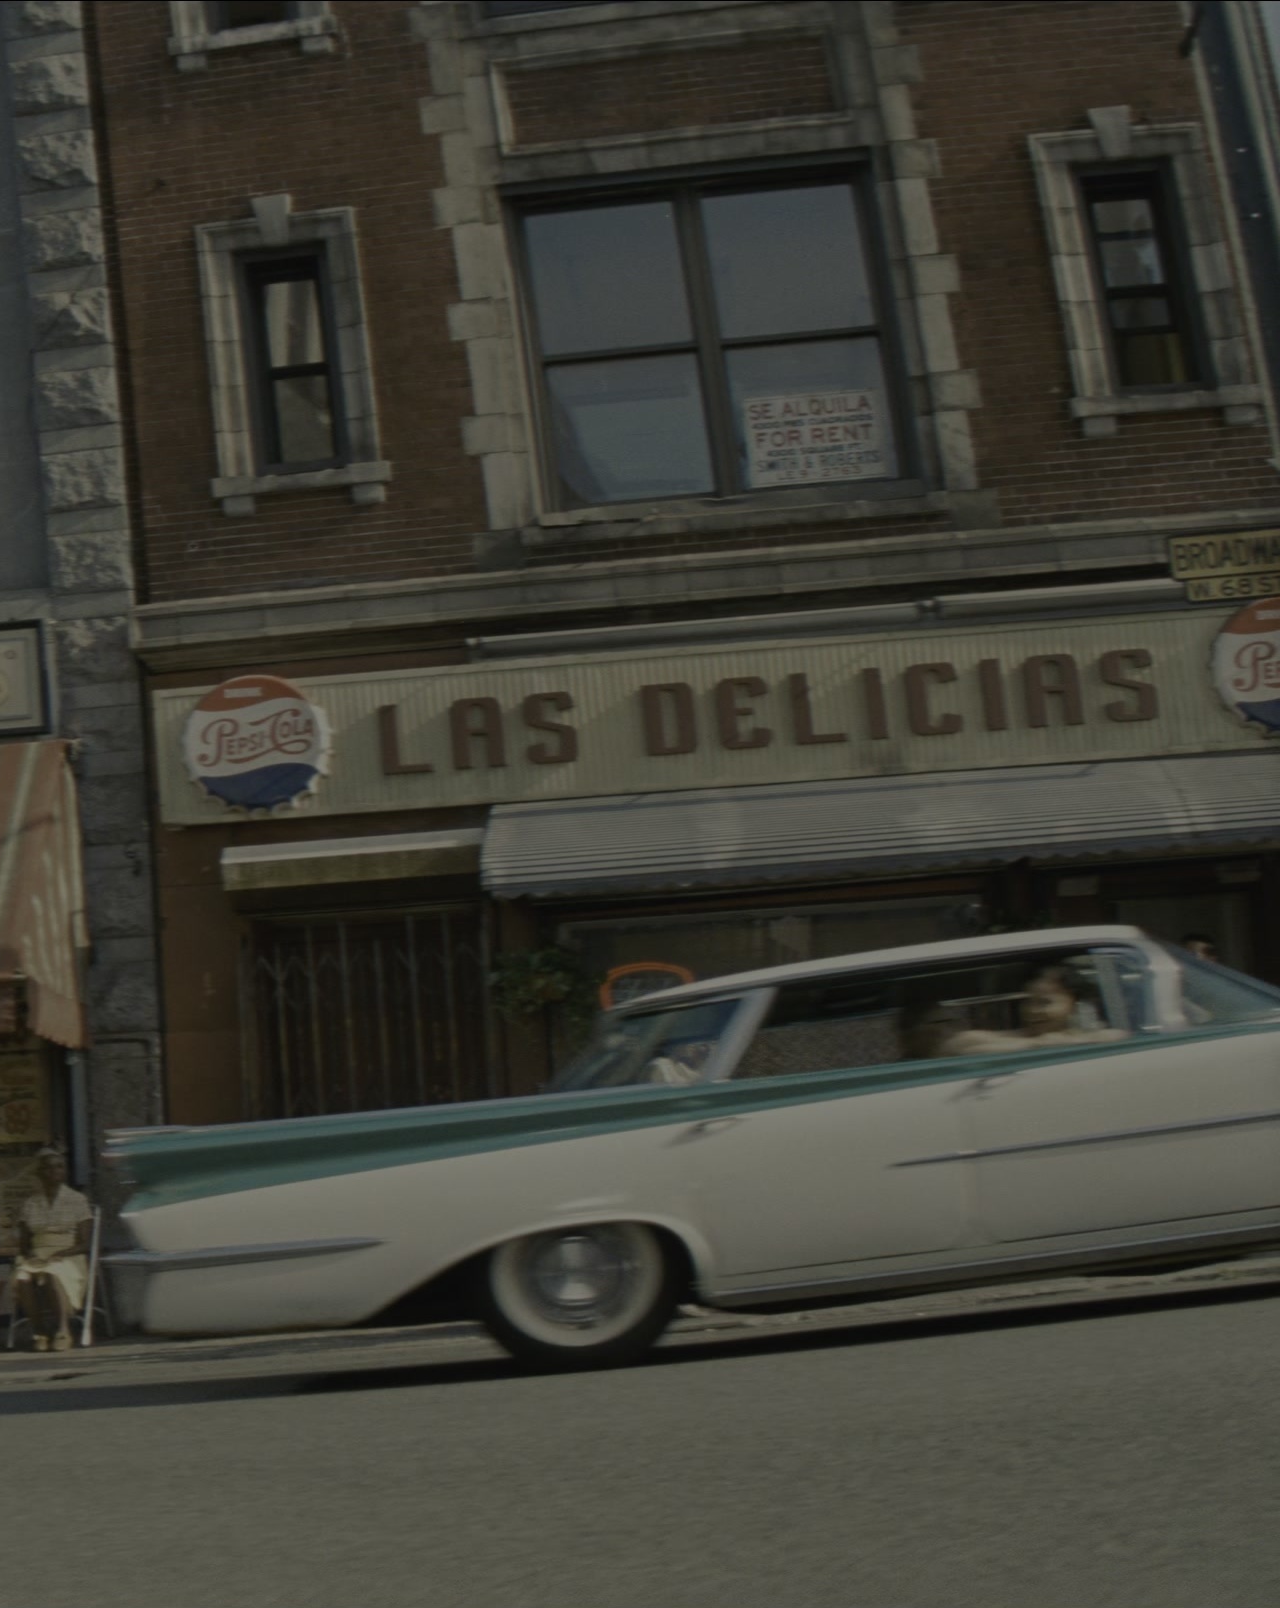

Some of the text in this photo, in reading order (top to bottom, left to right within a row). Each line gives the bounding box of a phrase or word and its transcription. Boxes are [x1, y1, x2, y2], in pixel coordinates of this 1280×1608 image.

[748, 395, 872, 421] SE ALQUILA
[755, 423, 873, 449] FOR RENT
[1175, 536, 1280, 571] BROADWA
[1222, 578, 1251, 596] 68
[378, 691, 578, 775] LAS
[641, 648, 1159, 756] DELICIAS
